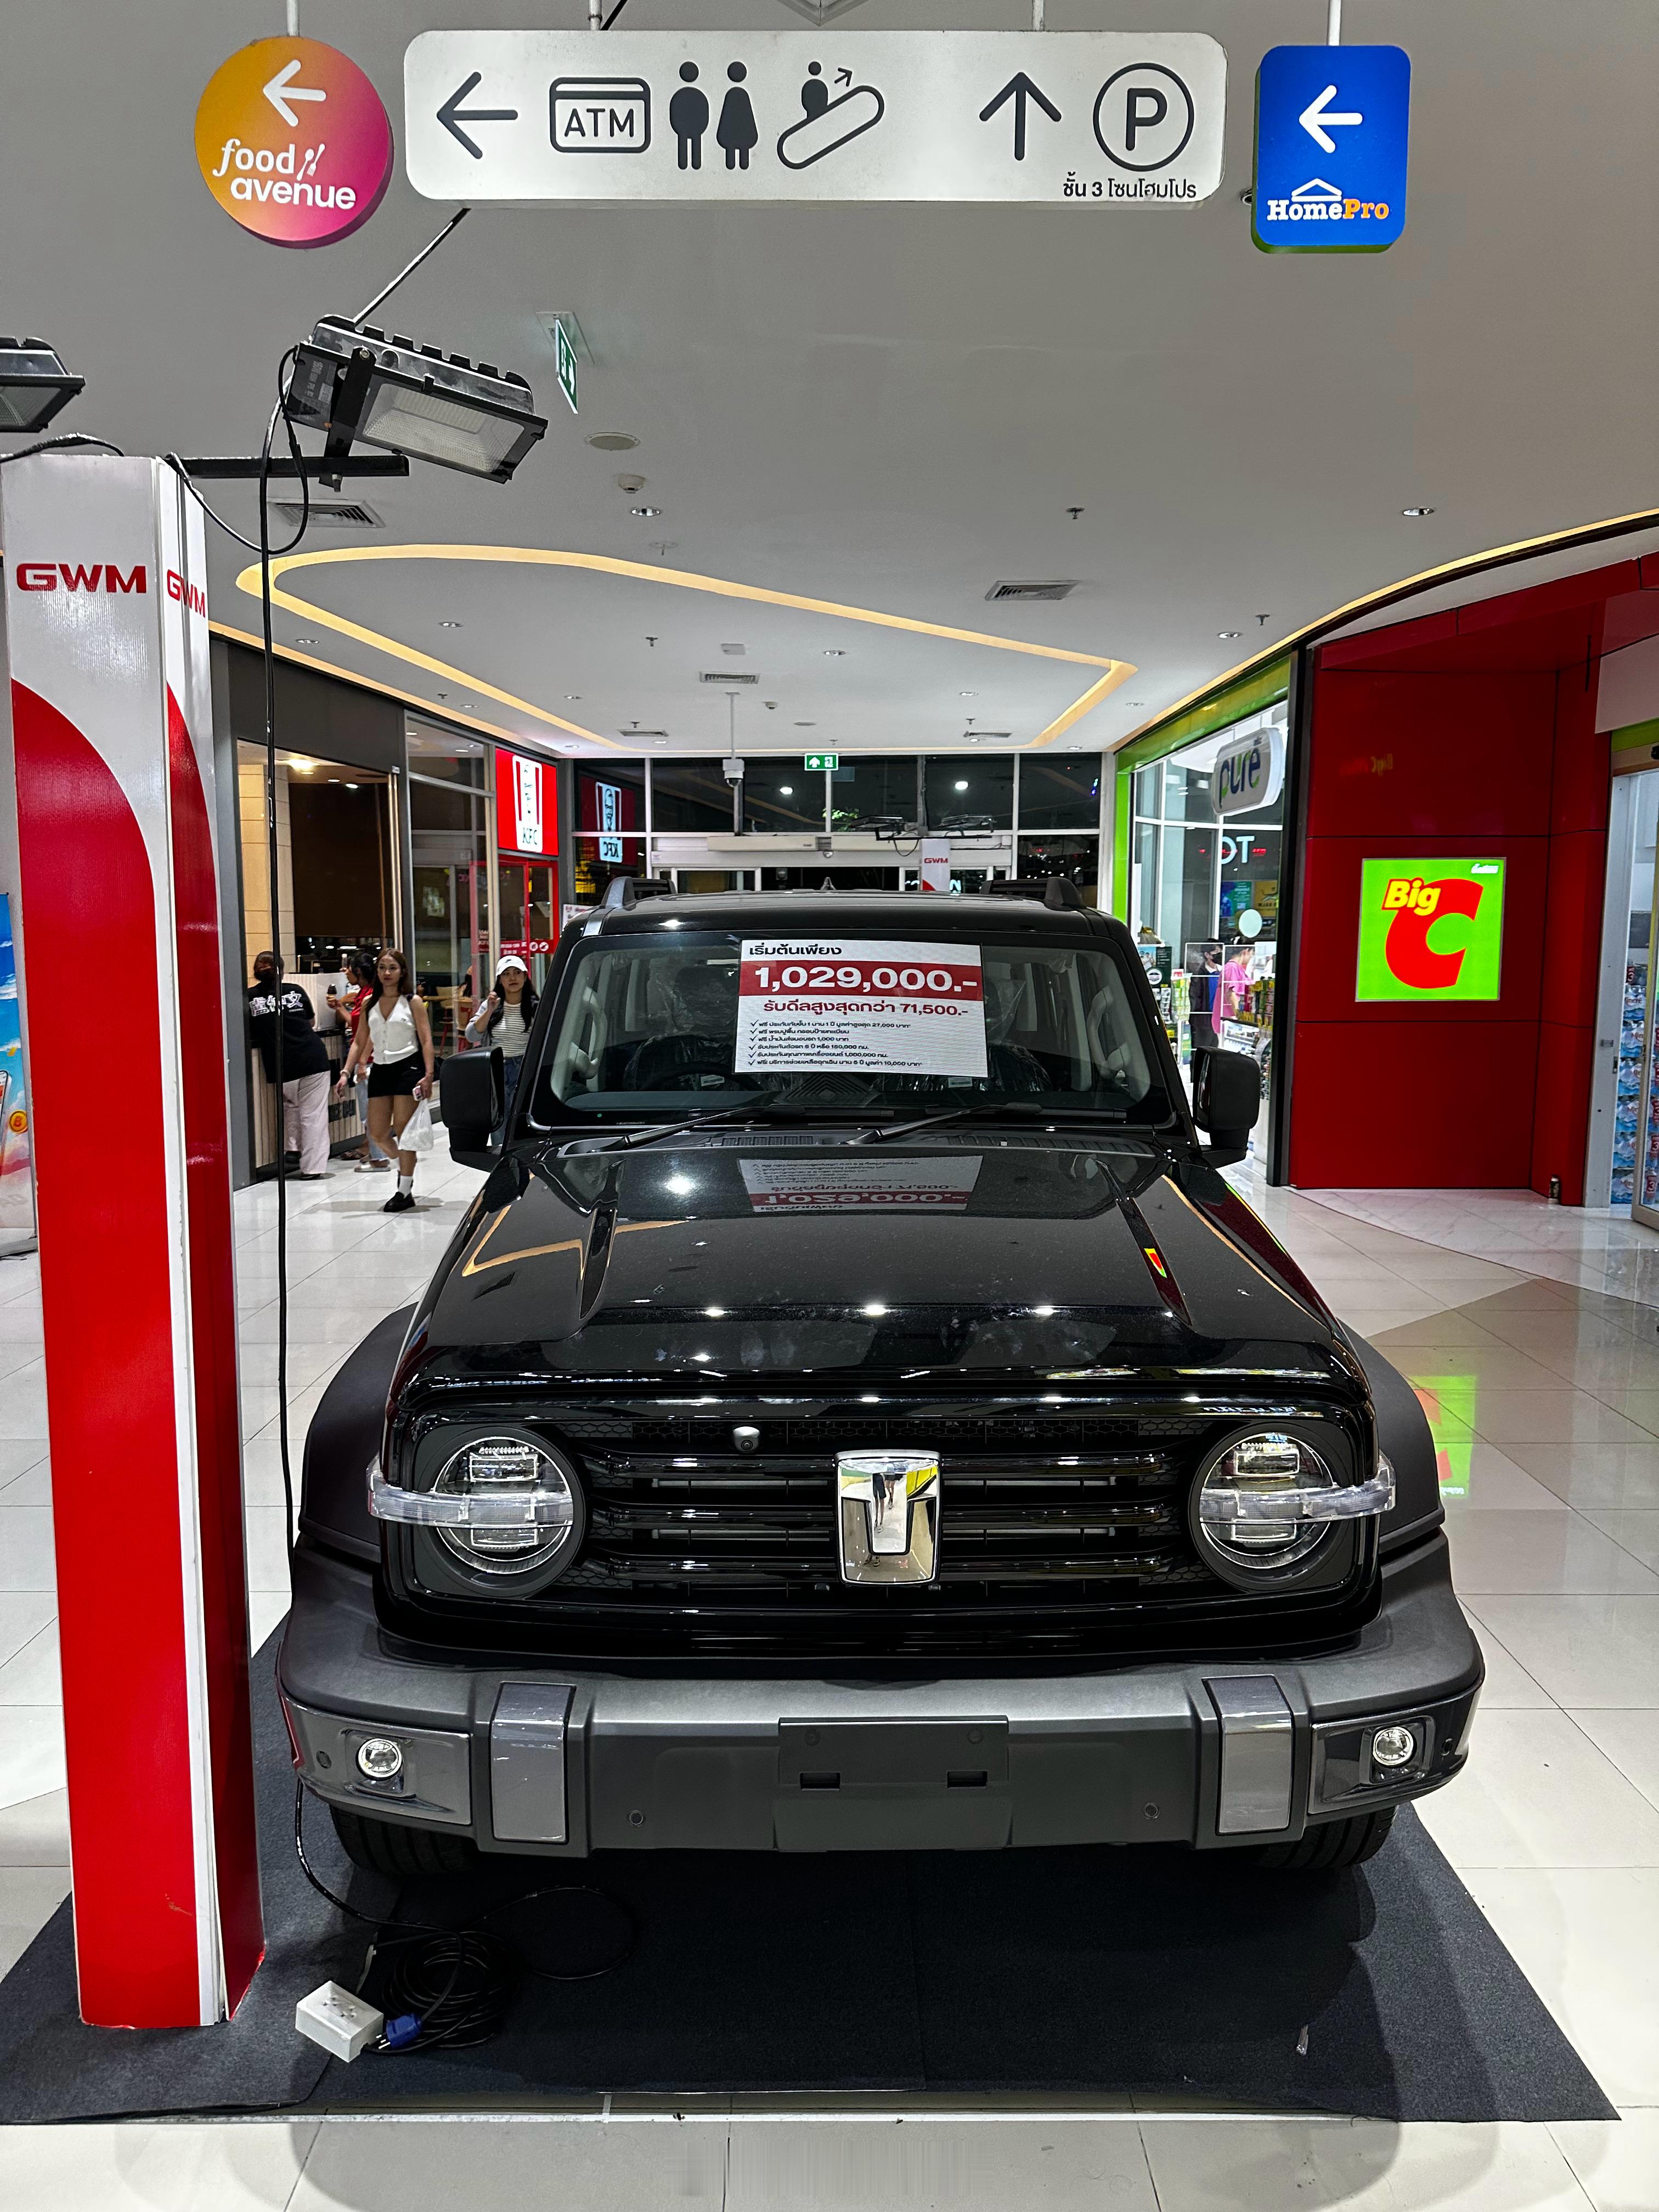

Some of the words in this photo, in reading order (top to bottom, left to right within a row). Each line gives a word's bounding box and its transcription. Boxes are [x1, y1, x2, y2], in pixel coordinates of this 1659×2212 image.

[564, 108, 635, 138] ATM
[1125, 87, 1168, 151] P
[212, 138, 295, 177] food
[230, 177, 356, 210] avenue
[1063, 172, 1086, 197] ชั้น
[1092, 182, 1103, 197] 3
[1108, 178, 1197, 198] โซนโฮมโปร
[1267, 199, 1389, 221] HomePro
[16, 563, 146, 594] GWM
[167, 569, 206, 618] GWM
[1219, 748, 1261, 809] pure
[522, 827, 538, 845] KFC
[1383, 878, 1441, 916] Big
[1385, 878, 1484, 989] C
[749, 943, 842, 956] เริ่มต้นเพียง
[755, 966, 978, 993] 1,029,000.-
[763, 999, 896, 1015] รับดีลสูงสุดกว่า
[900, 1003, 968, 1017] 71,500.-
